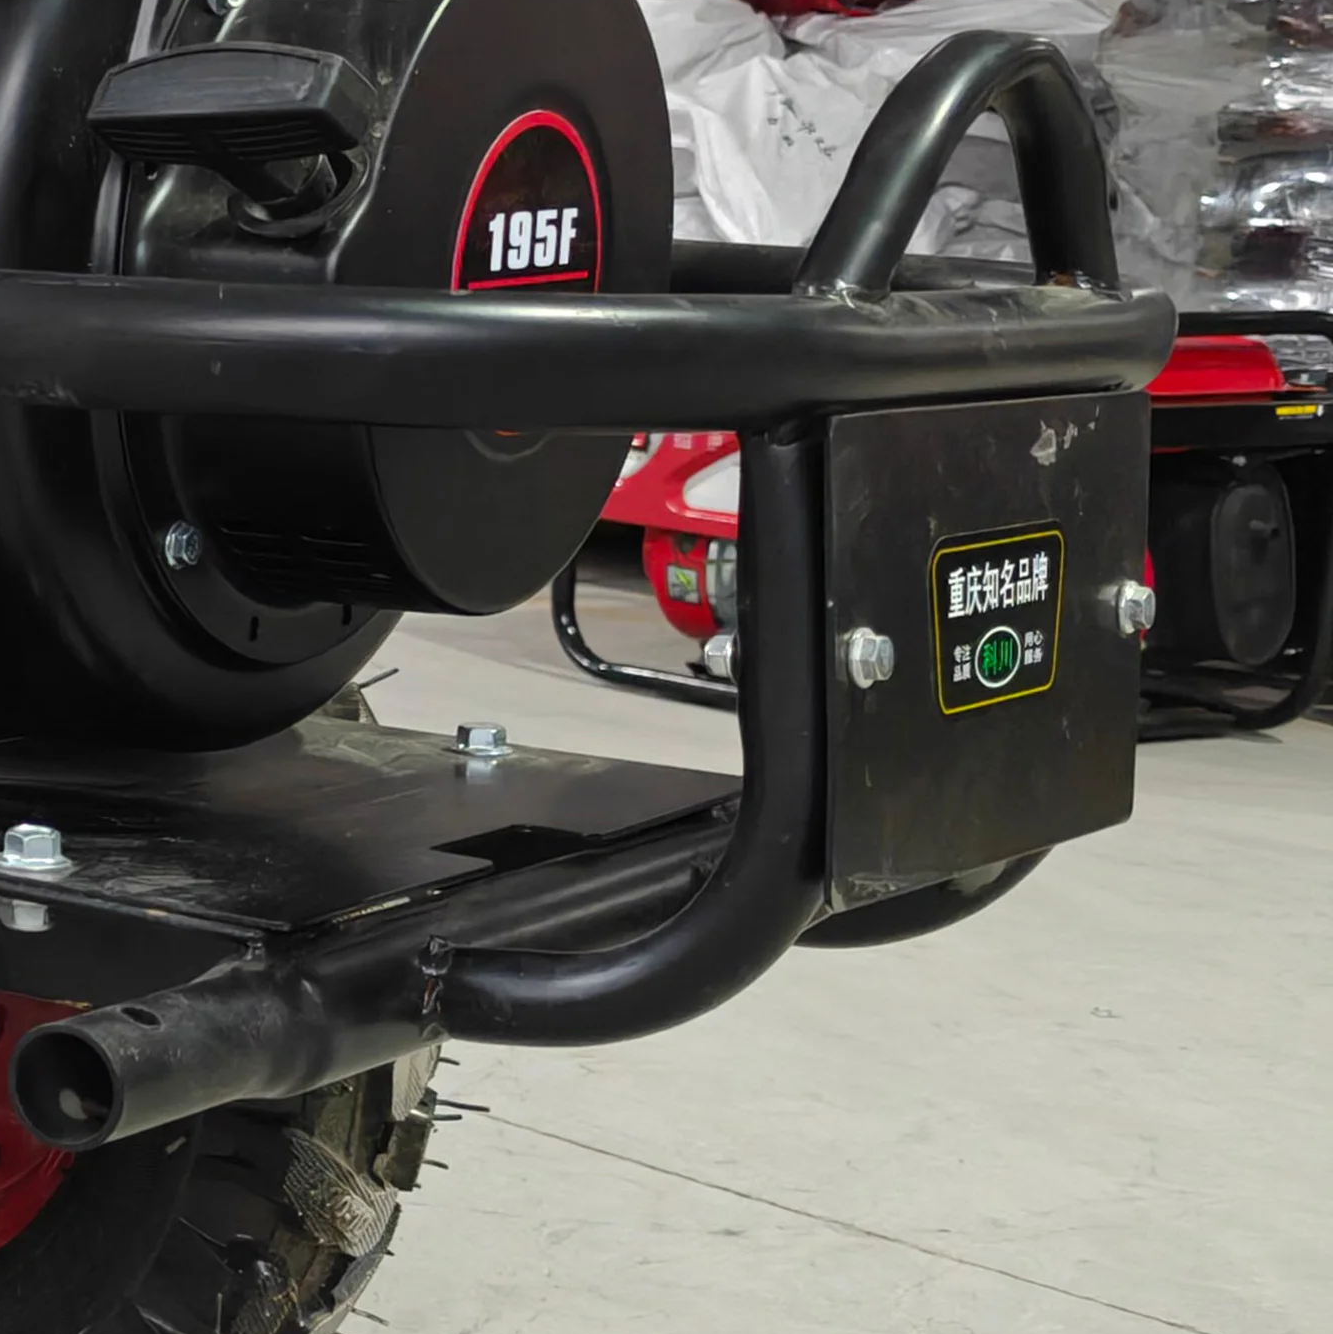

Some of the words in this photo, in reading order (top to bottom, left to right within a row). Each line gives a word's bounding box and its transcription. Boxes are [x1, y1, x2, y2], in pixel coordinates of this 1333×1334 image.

[489, 207, 579, 272] 195F
[948, 551, 1049, 619] 重庆知名品牌
